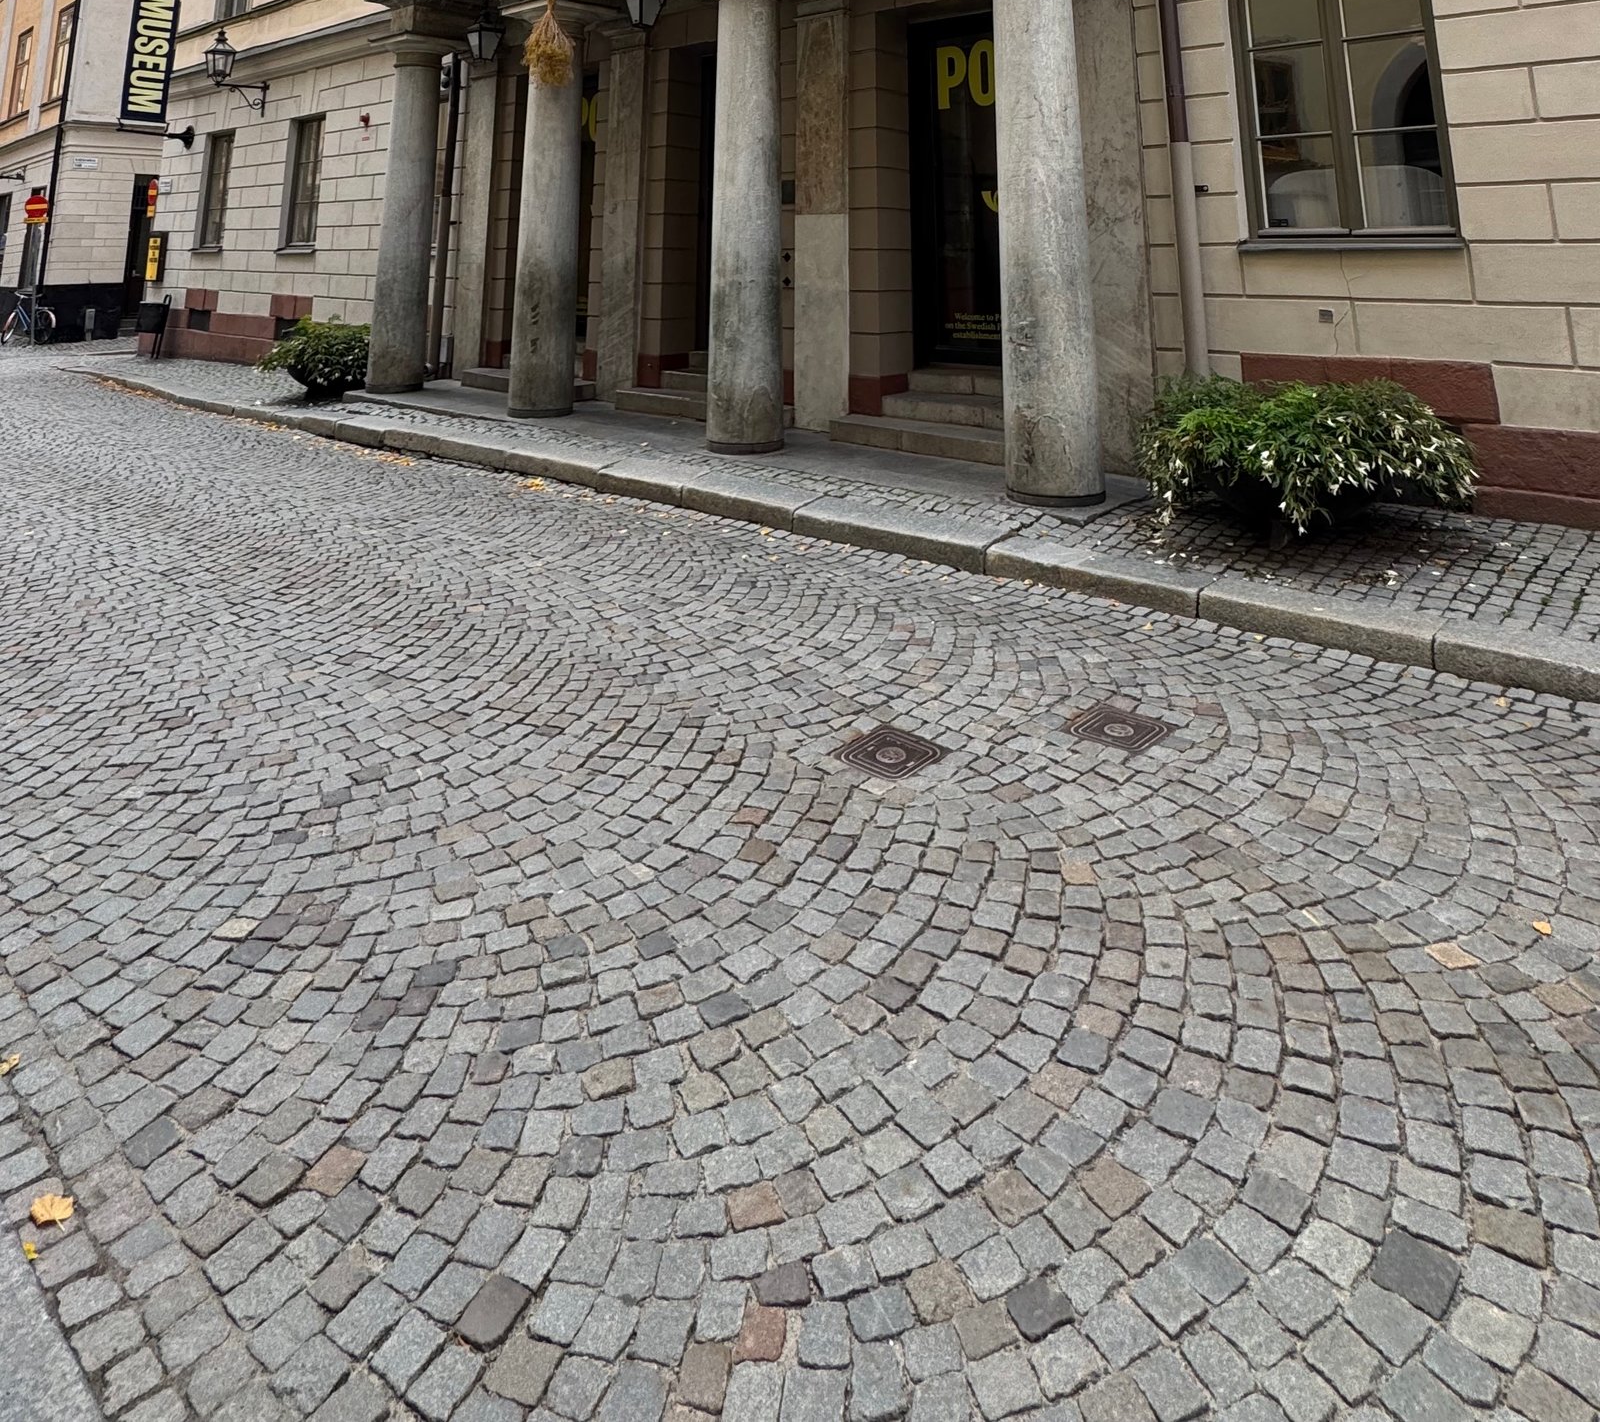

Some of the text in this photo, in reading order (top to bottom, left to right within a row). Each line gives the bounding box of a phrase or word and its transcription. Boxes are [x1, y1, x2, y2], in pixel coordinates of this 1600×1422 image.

[954, 312, 986, 321] Welcome
[954, 321, 967, 330] the
[966, 321, 996, 331] Swedish
